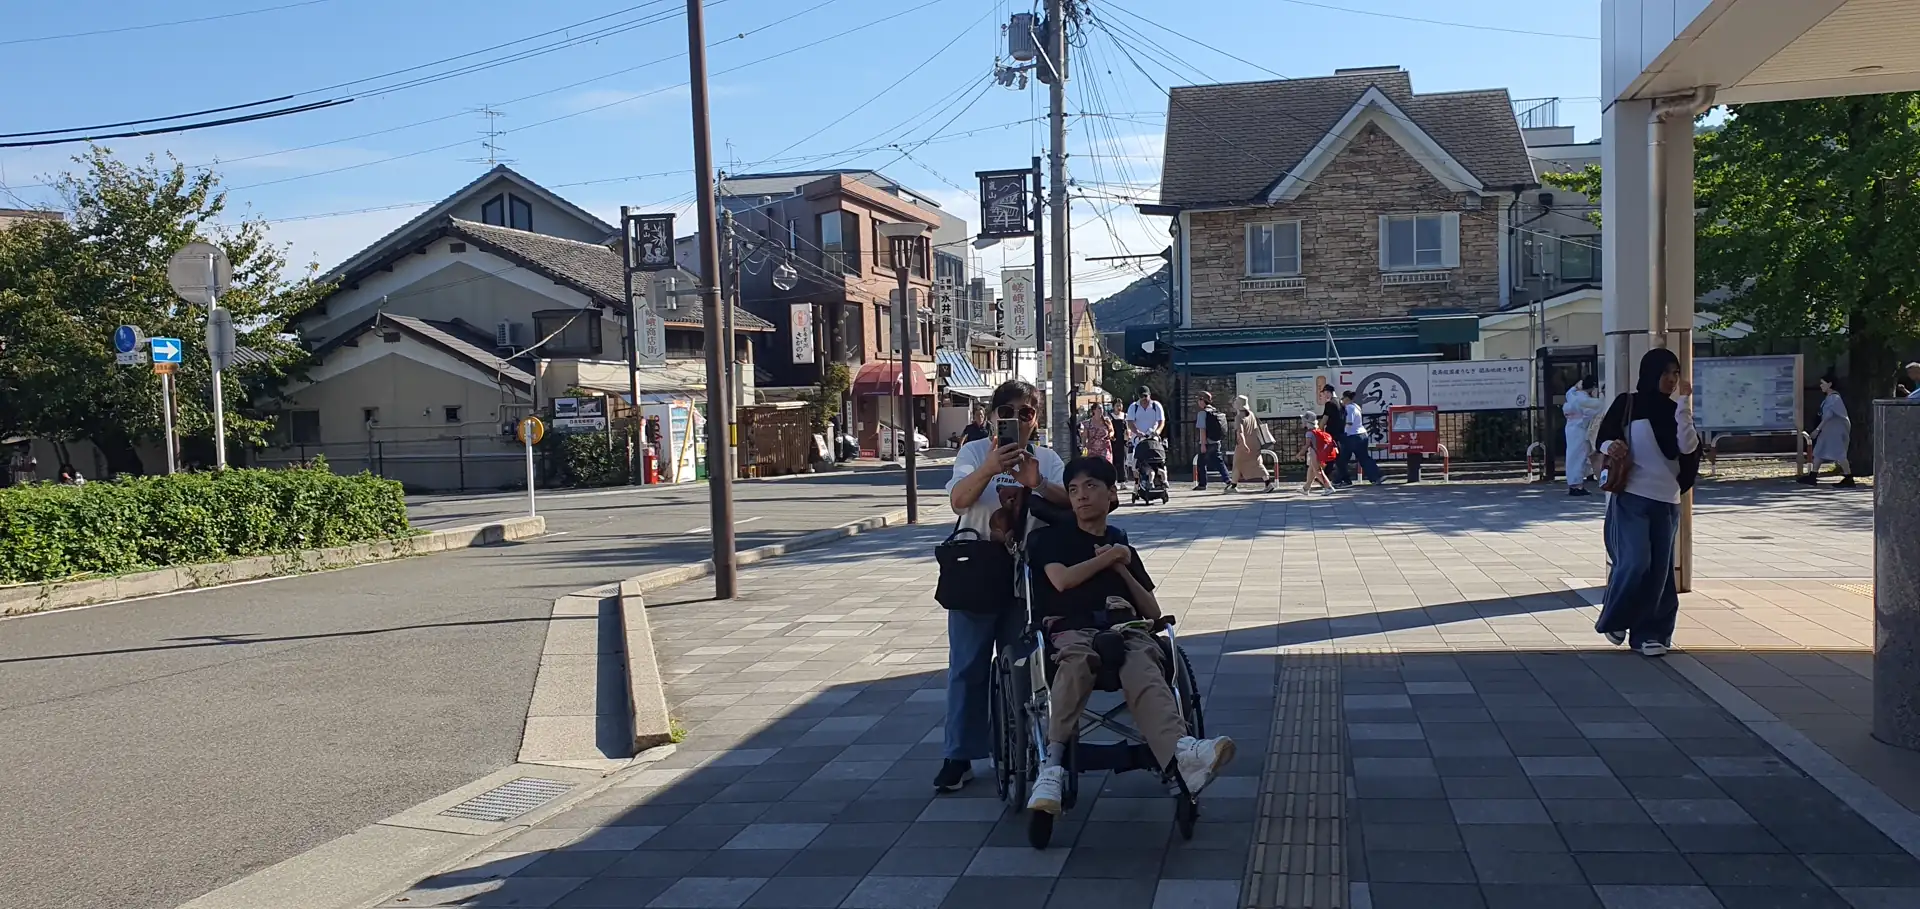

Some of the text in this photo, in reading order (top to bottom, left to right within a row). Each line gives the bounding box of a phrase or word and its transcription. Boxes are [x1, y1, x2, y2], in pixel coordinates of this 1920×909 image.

[1012, 282, 1027, 336] 嵯峨商店街
